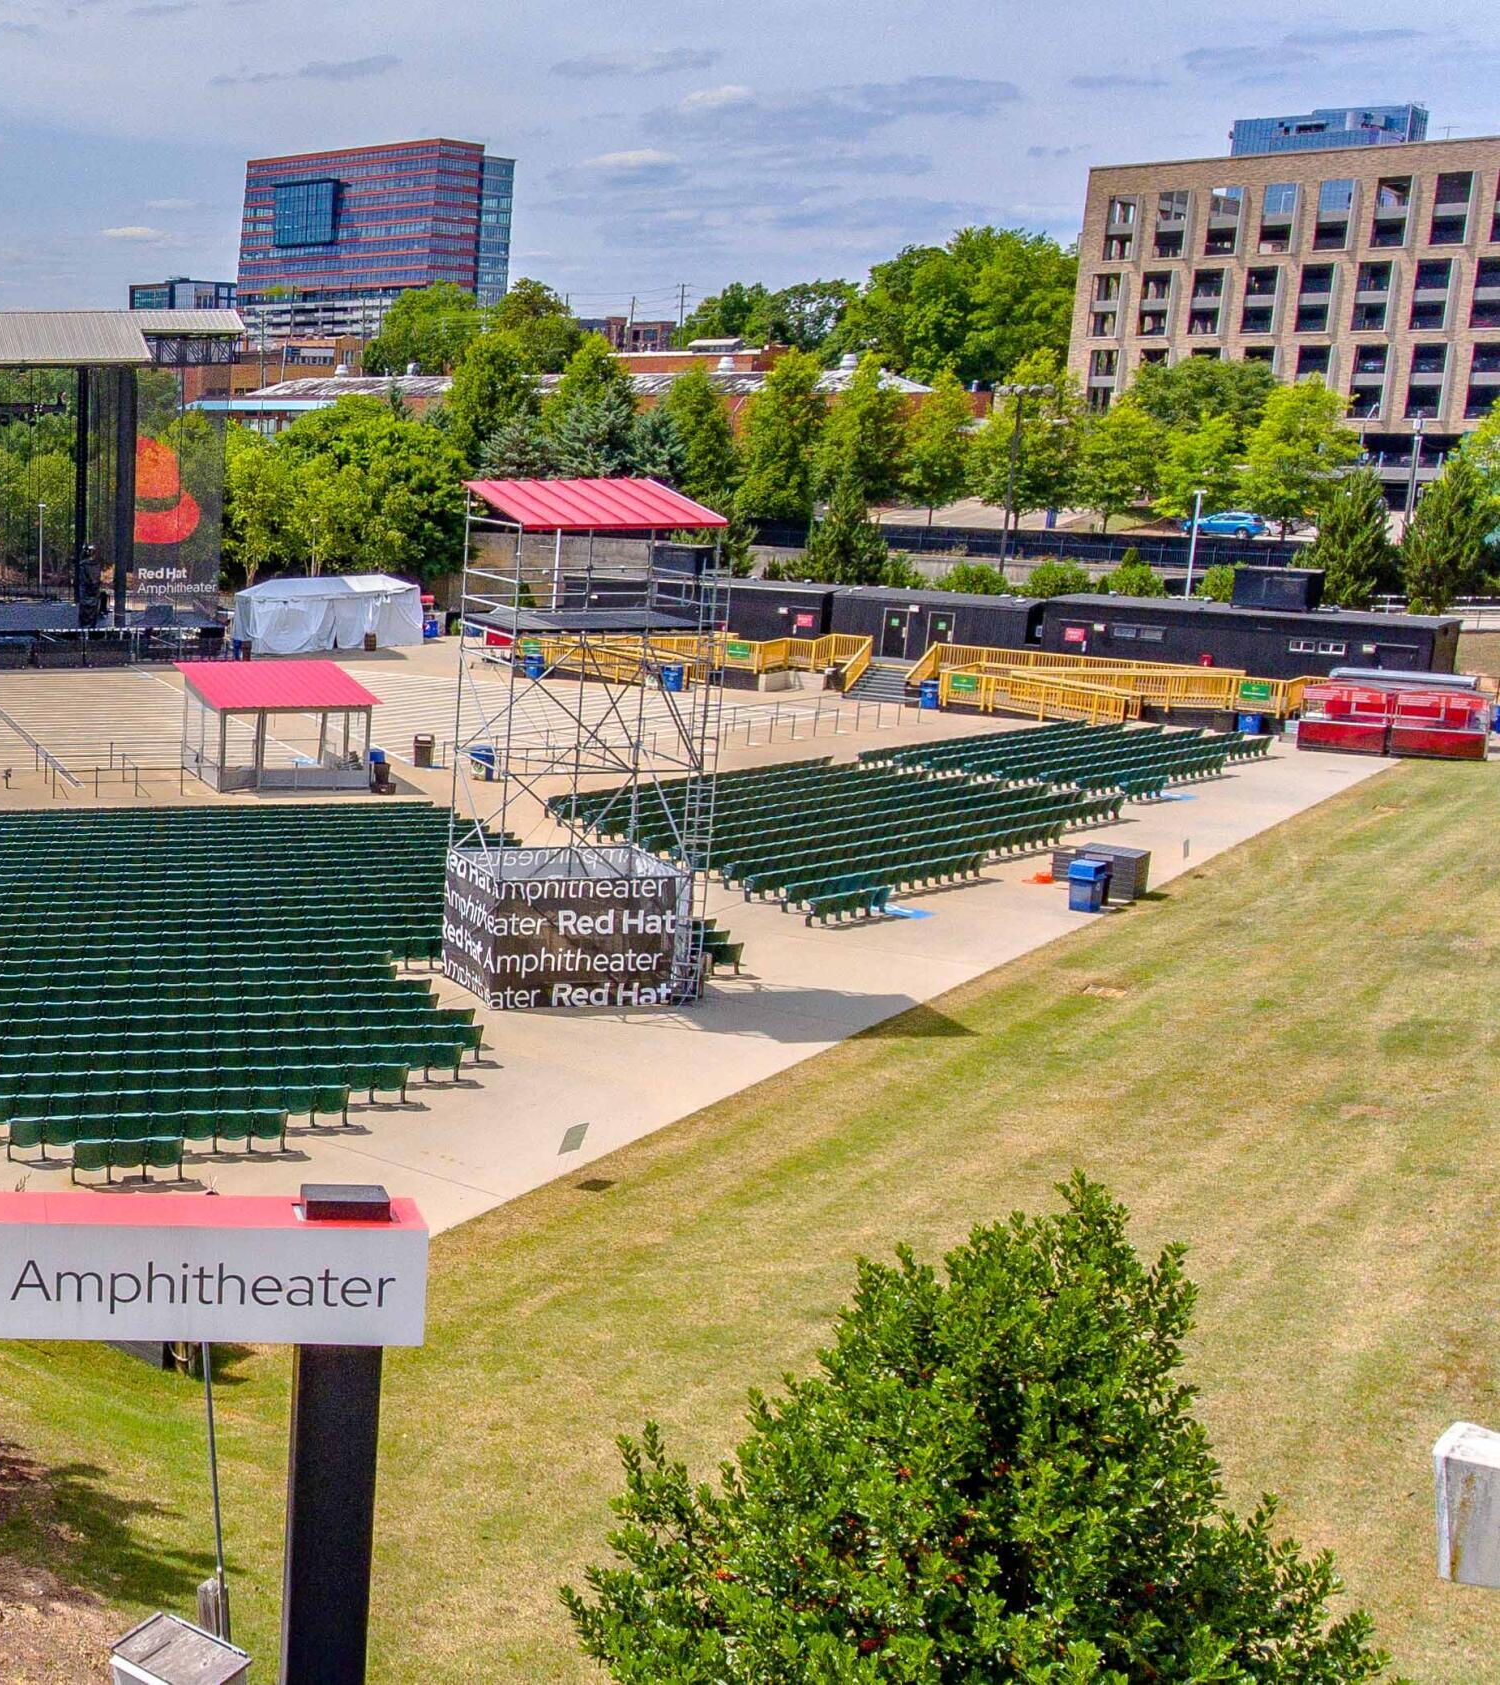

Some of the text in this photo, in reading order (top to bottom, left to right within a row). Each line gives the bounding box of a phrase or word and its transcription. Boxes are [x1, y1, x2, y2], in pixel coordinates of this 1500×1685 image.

[138, 568, 187, 579] Red Hat
[138, 583, 217, 595] Amphitheater
[558, 908, 614, 936] Red
[622, 908, 676, 935] Hat
[464, 928, 483, 965] Hat
[483, 946, 663, 979] Amphitheater
[551, 982, 611, 1007] Red
[617, 982, 672, 1005] Hat
[10, 1258, 397, 1315] Amphitheater
